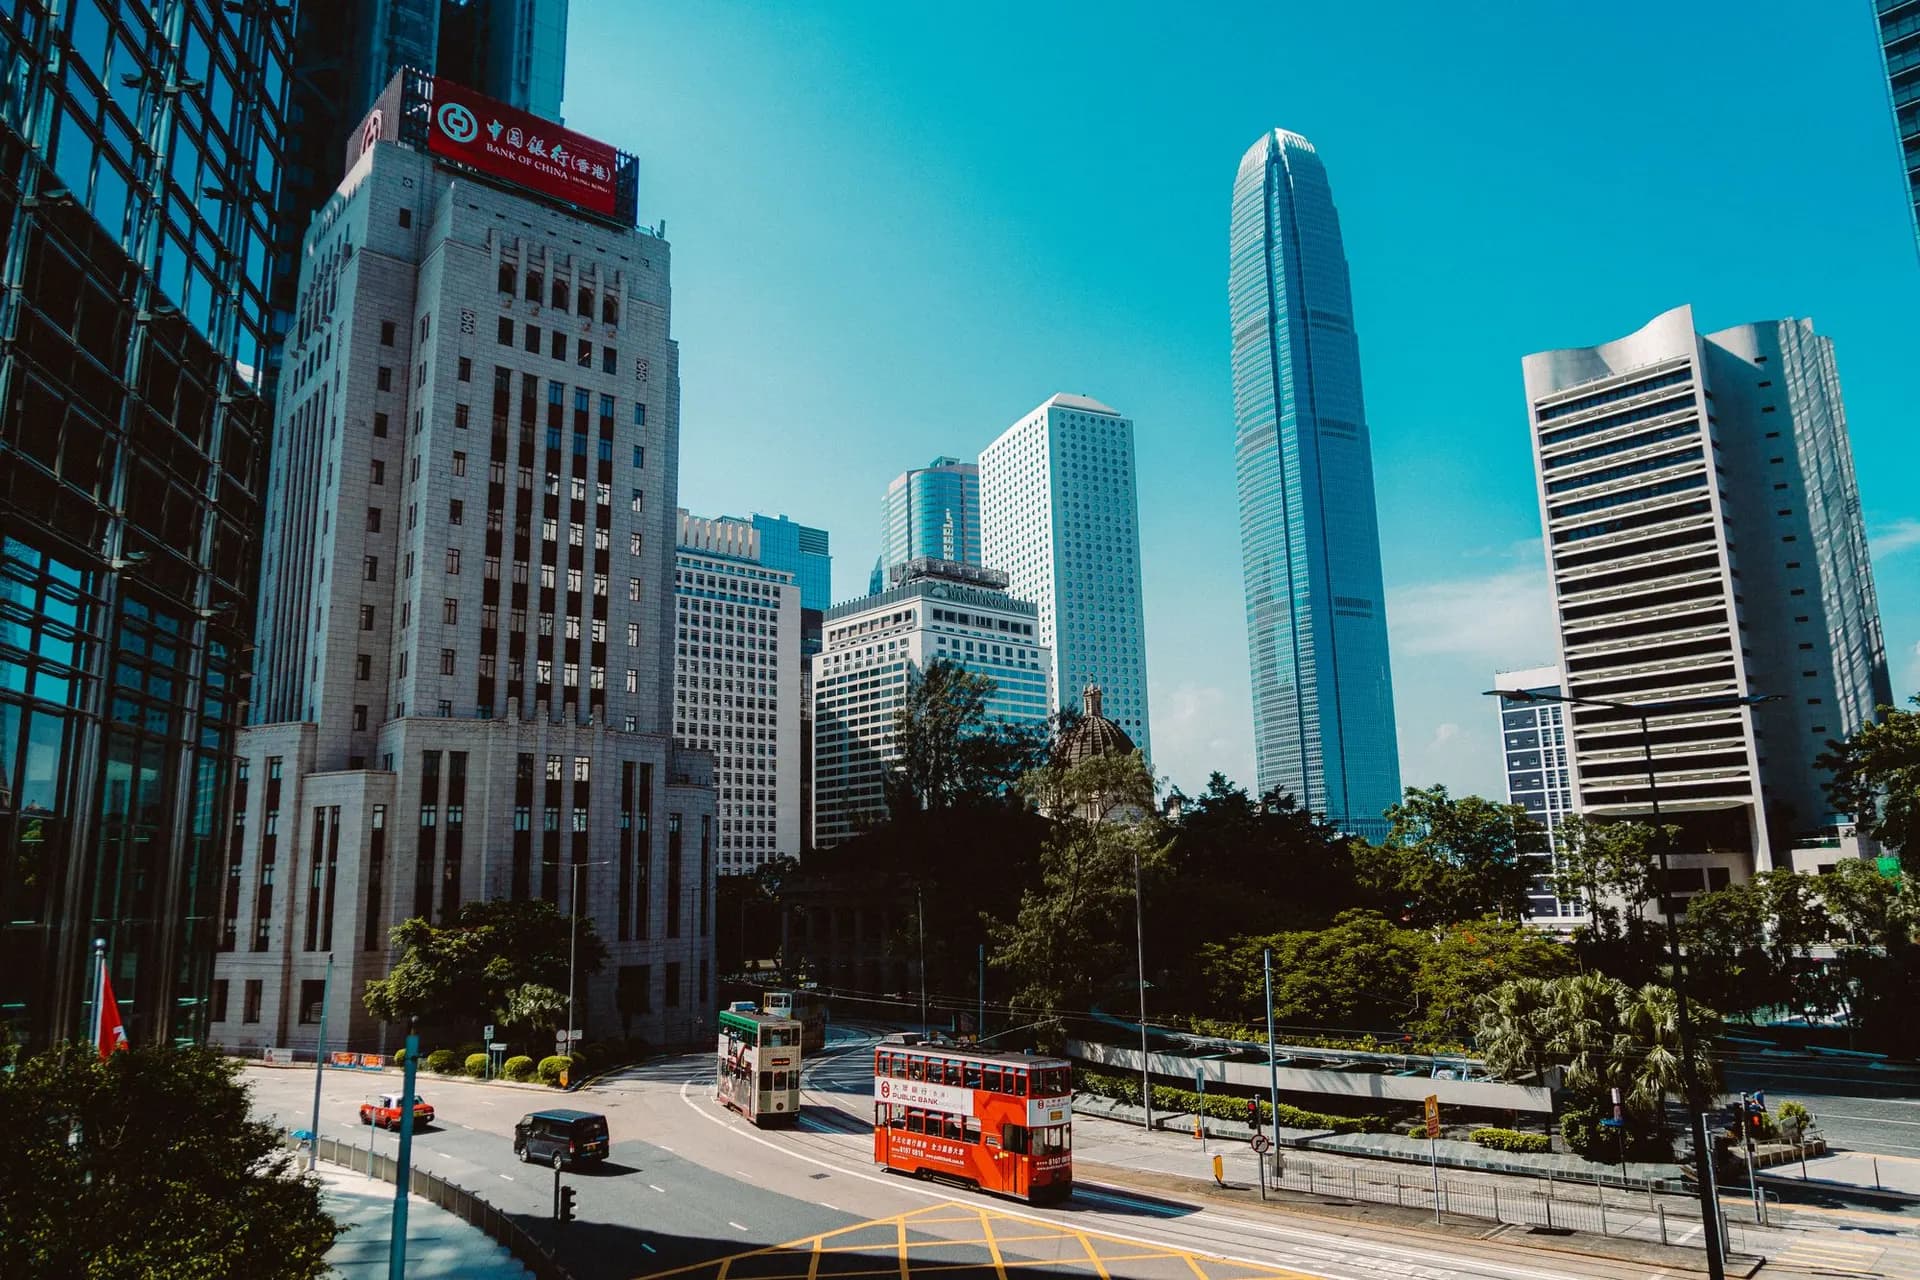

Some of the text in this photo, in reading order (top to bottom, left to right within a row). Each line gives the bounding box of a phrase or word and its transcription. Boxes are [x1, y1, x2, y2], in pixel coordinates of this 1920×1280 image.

[486, 143, 516, 161] BANK
[518, 155, 532, 166] OF
[534, 161, 568, 180] CHINA
[950, 590, 994, 605] MANDARIN
[892, 1092, 938, 1105] PUBLIC BANK
